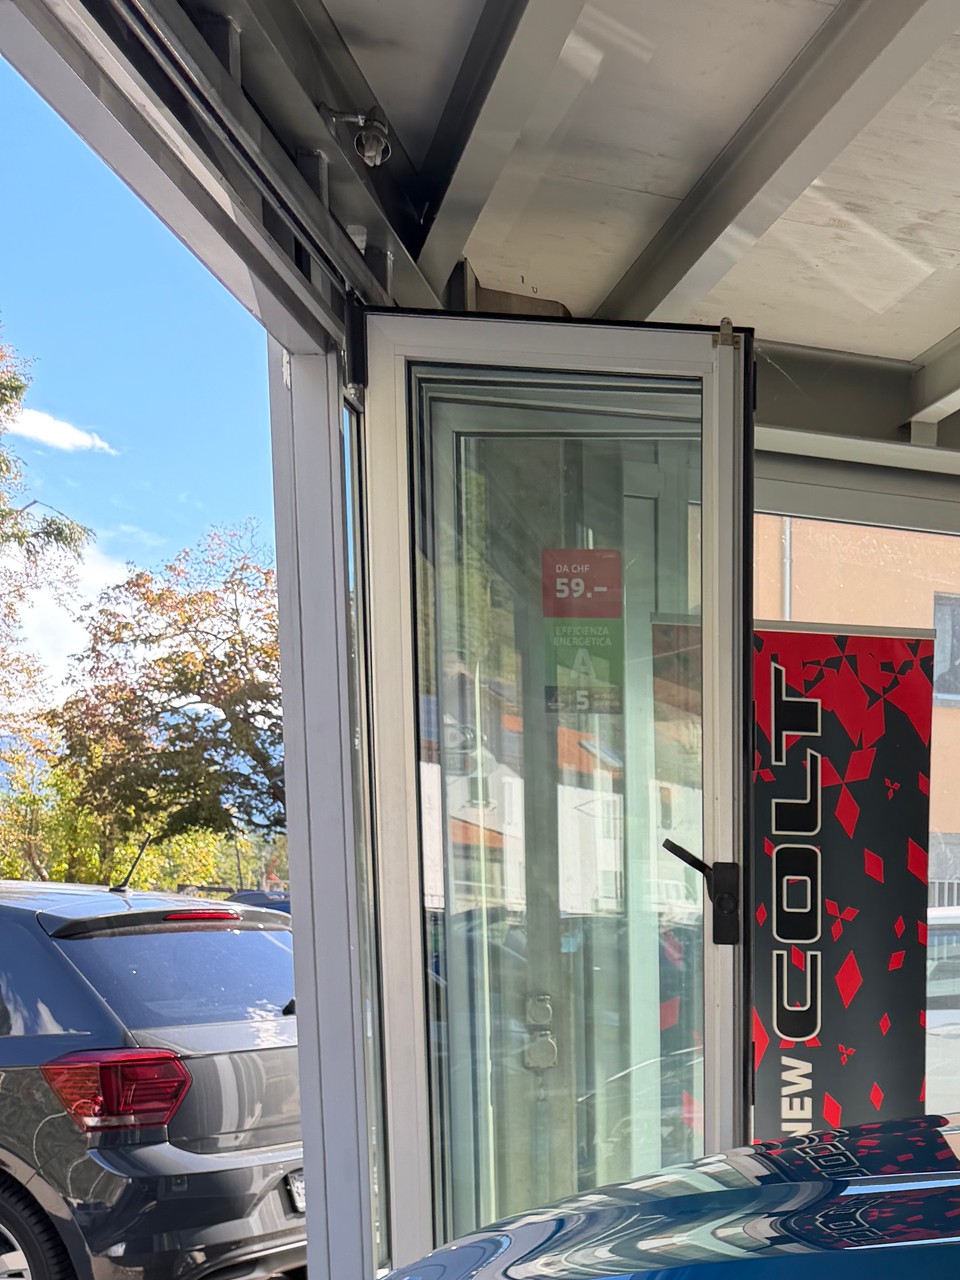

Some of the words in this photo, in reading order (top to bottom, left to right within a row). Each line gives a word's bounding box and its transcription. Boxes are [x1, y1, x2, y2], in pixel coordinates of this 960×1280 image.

[555, 564, 569, 573] DA
[571, 564, 590, 573] CHF
[555, 626, 609, 636] EFFICIENZA
[553, 637, 612, 647] ENERGETICA
[570, 648, 596, 679] A
[576, 690, 590, 710] 5
[771, 661, 822, 1043] COLT
[780, 1055, 813, 1137] NEW
